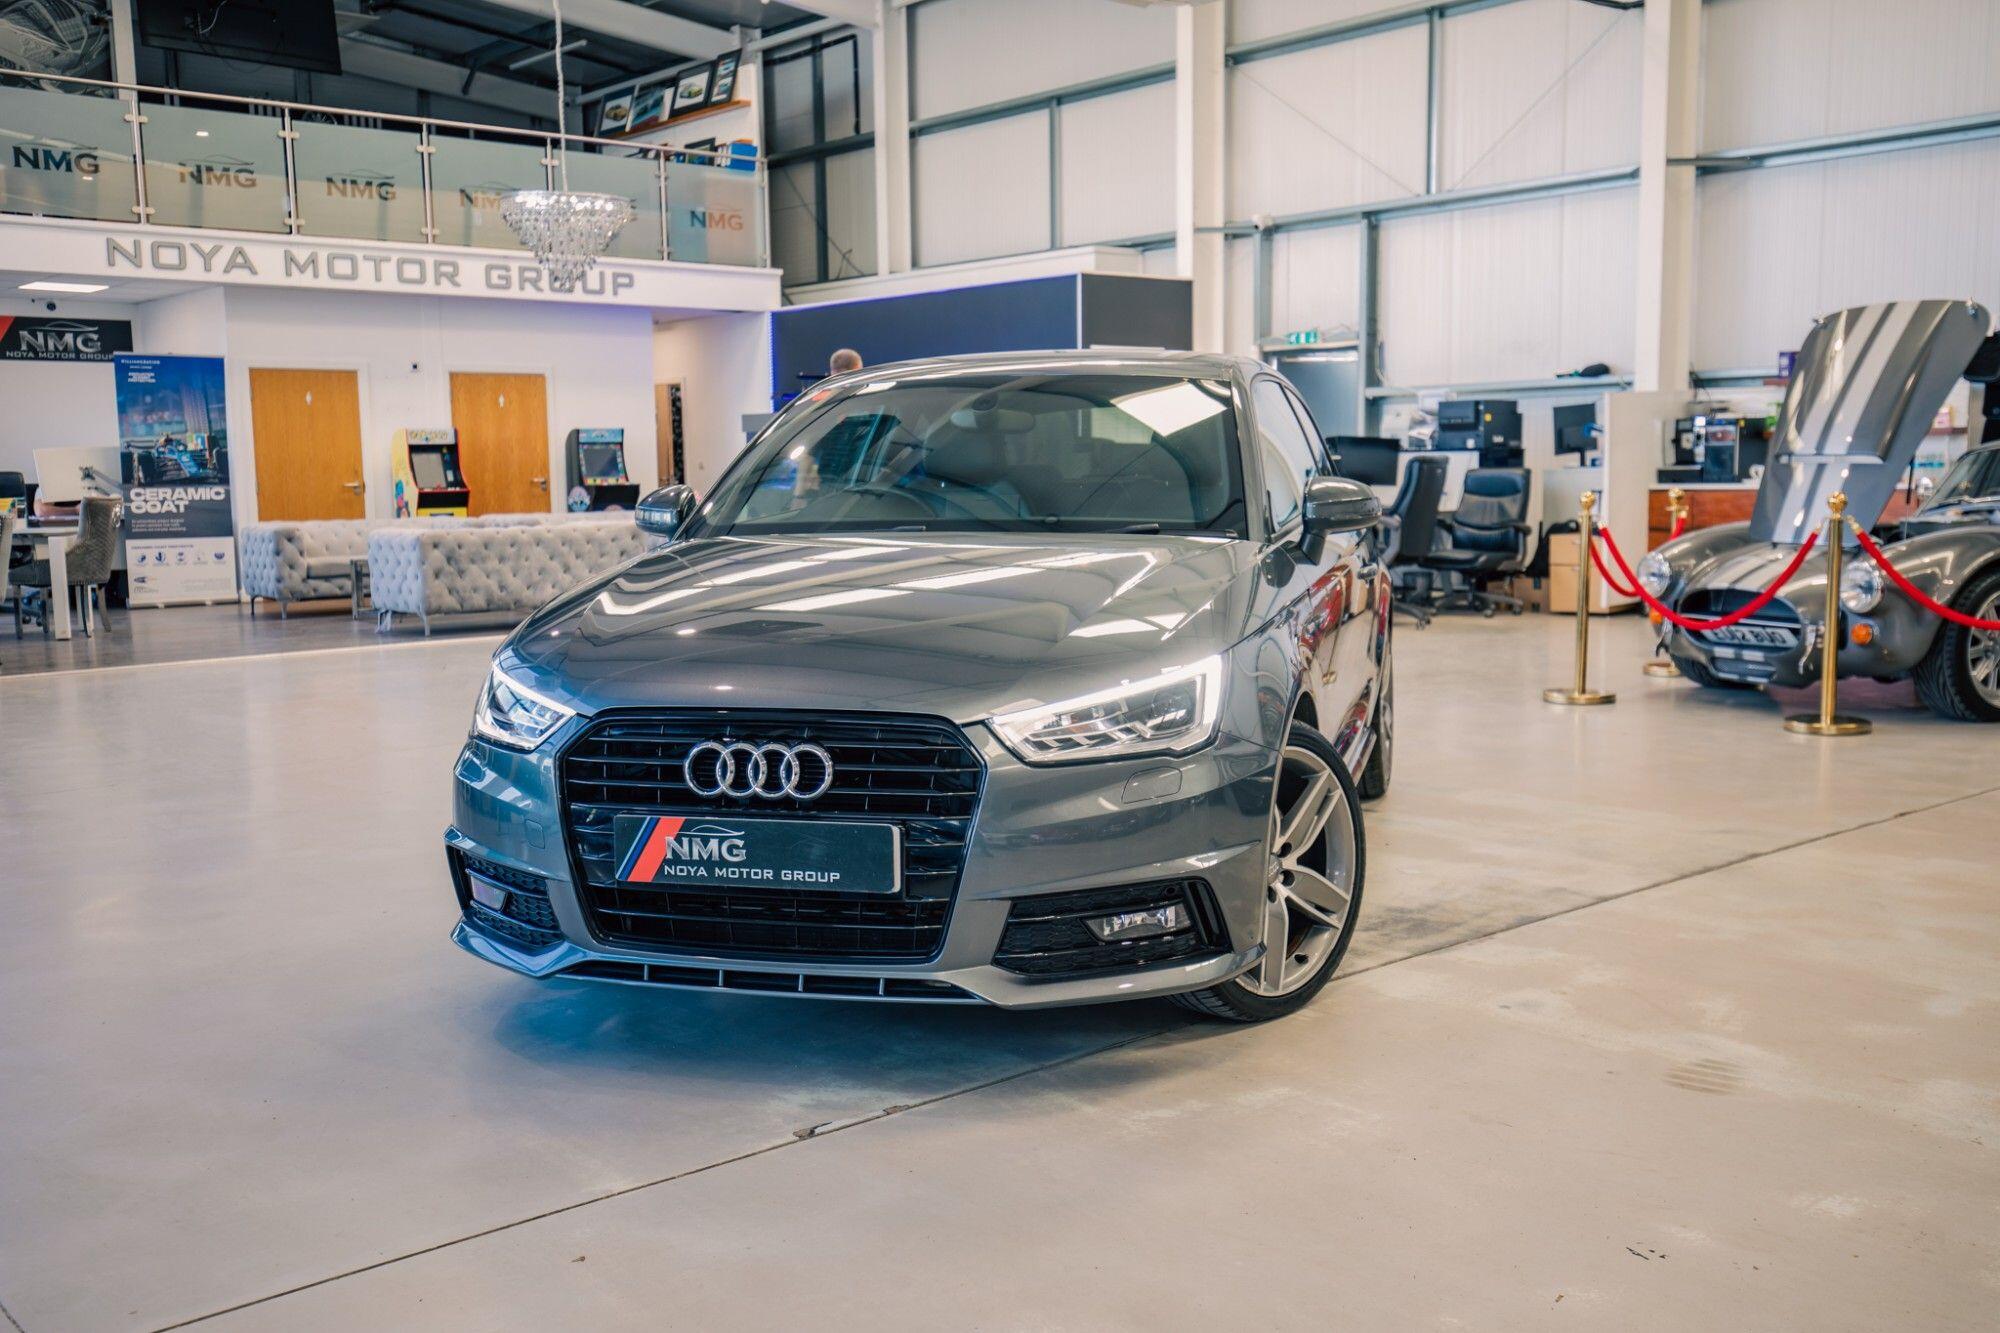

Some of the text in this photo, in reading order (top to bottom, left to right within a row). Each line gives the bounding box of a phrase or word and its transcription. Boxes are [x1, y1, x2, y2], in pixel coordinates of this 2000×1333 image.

[12, 145, 100, 175] NMG
[179, 162, 257, 189] NMG
[326, 177, 397, 201] NMG
[690, 209, 744, 232] NMG
[106, 237, 258, 275] NOYA
[284, 249, 461, 287] MOTOR
[19, 331, 101, 353] NMG
[6, 350, 35, 358] NOYA
[39, 351, 76, 359] MOTOR
[130, 487, 225, 501] CERAMIC
[131, 500, 189, 513] COAT
[664, 835, 747, 862] NMG
[664, 865, 840, 883] NOYA MOTOR GROUP
